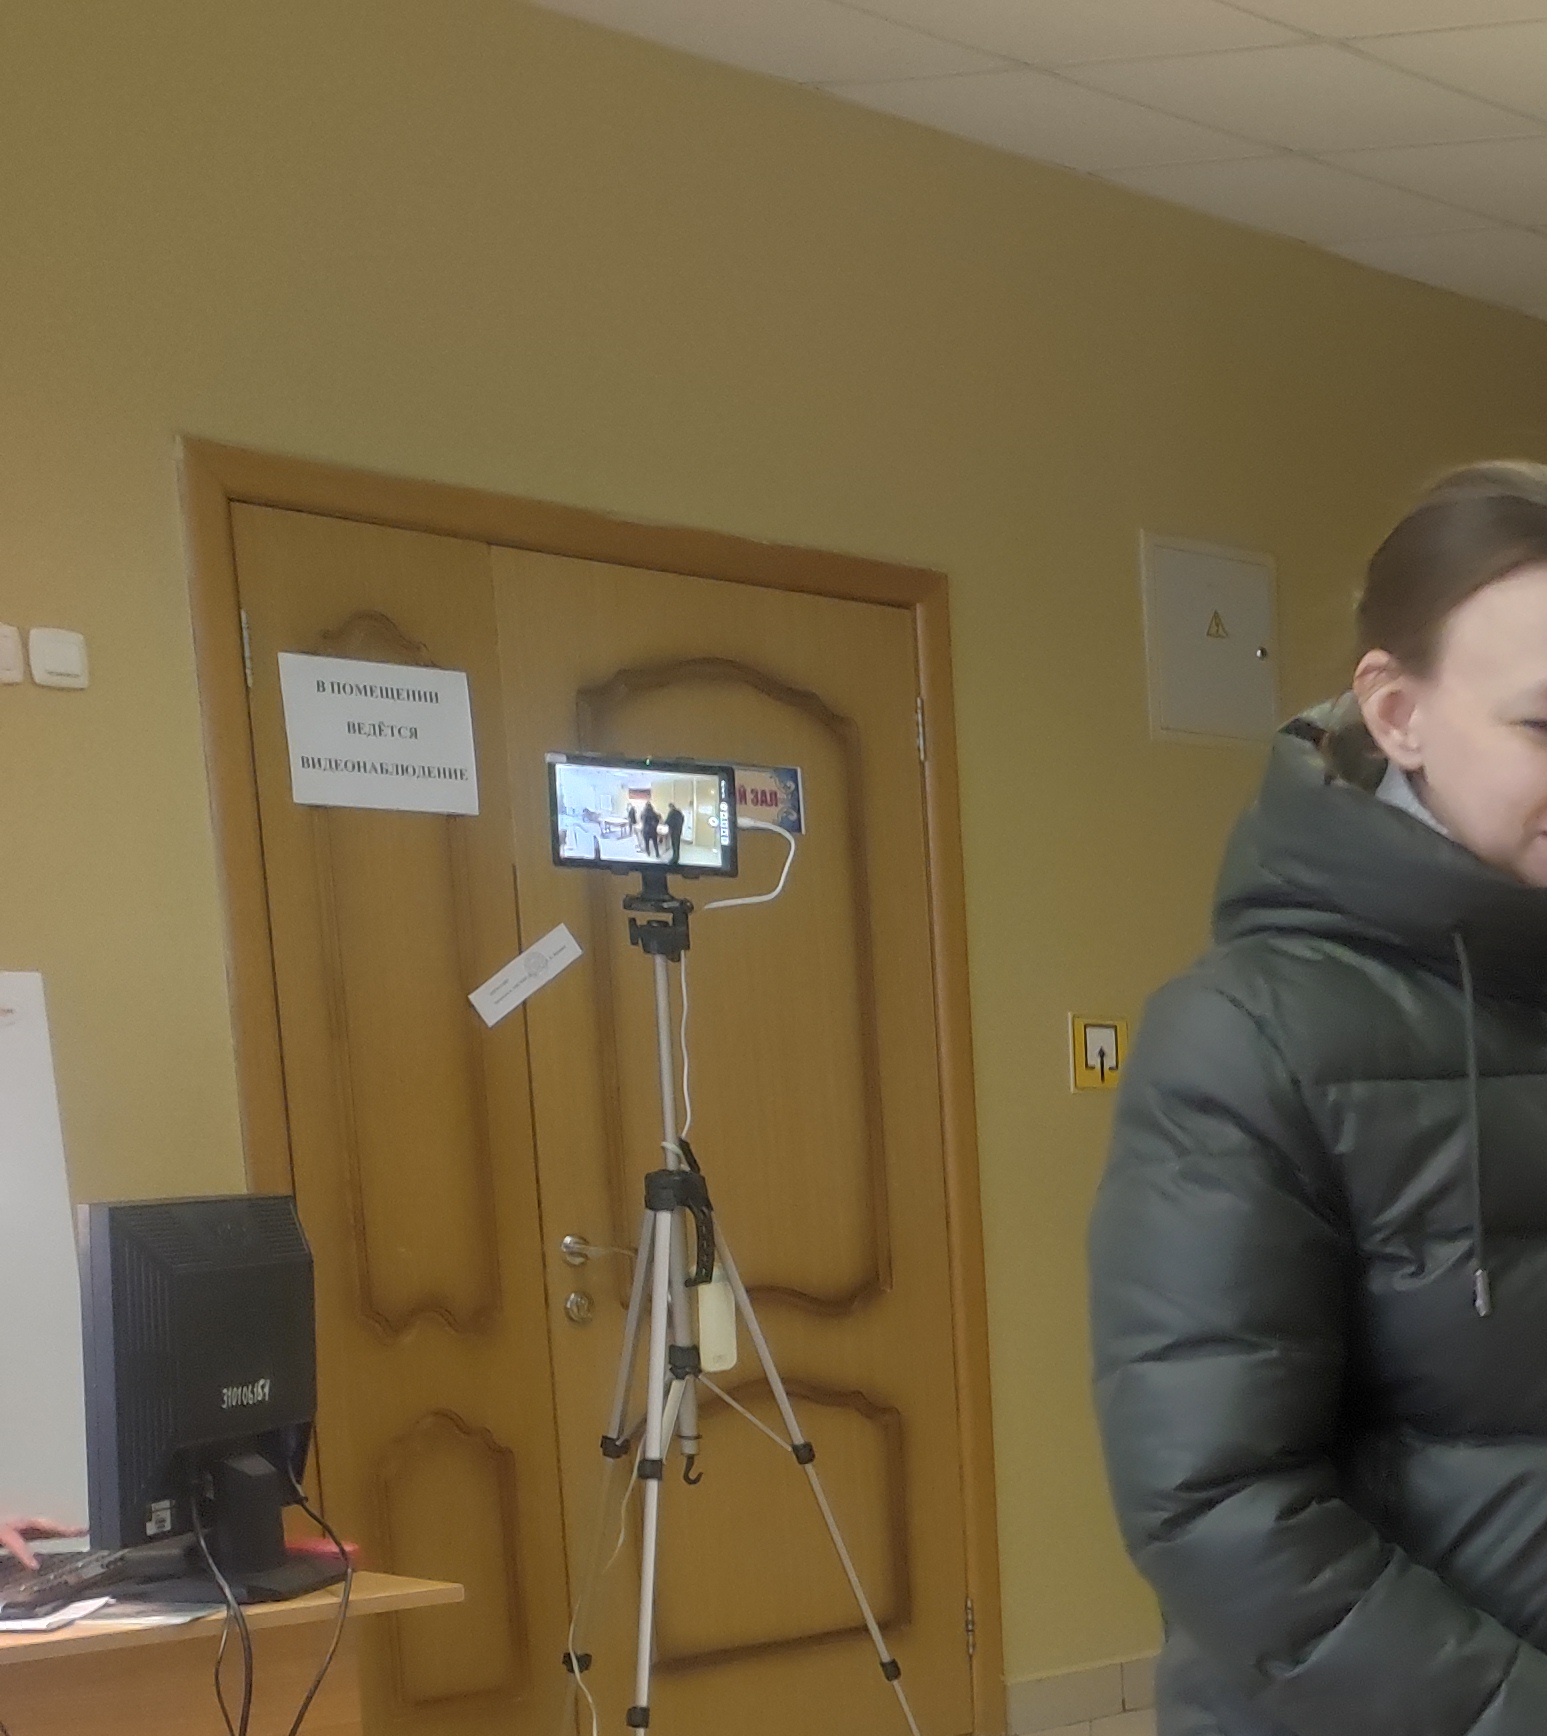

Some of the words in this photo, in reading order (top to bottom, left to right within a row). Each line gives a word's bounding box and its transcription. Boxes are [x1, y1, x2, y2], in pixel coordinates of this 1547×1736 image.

[316, 679, 326, 693] В
[329, 681, 440, 704] ПОМЕЩЕНИИ
[347, 721, 418, 740] ВЕДЁТСЯ
[300, 755, 468, 781] ВИДЕОНАБЛЮДЕНИЕ
[750, 788, 779, 807] ЗАЛ
